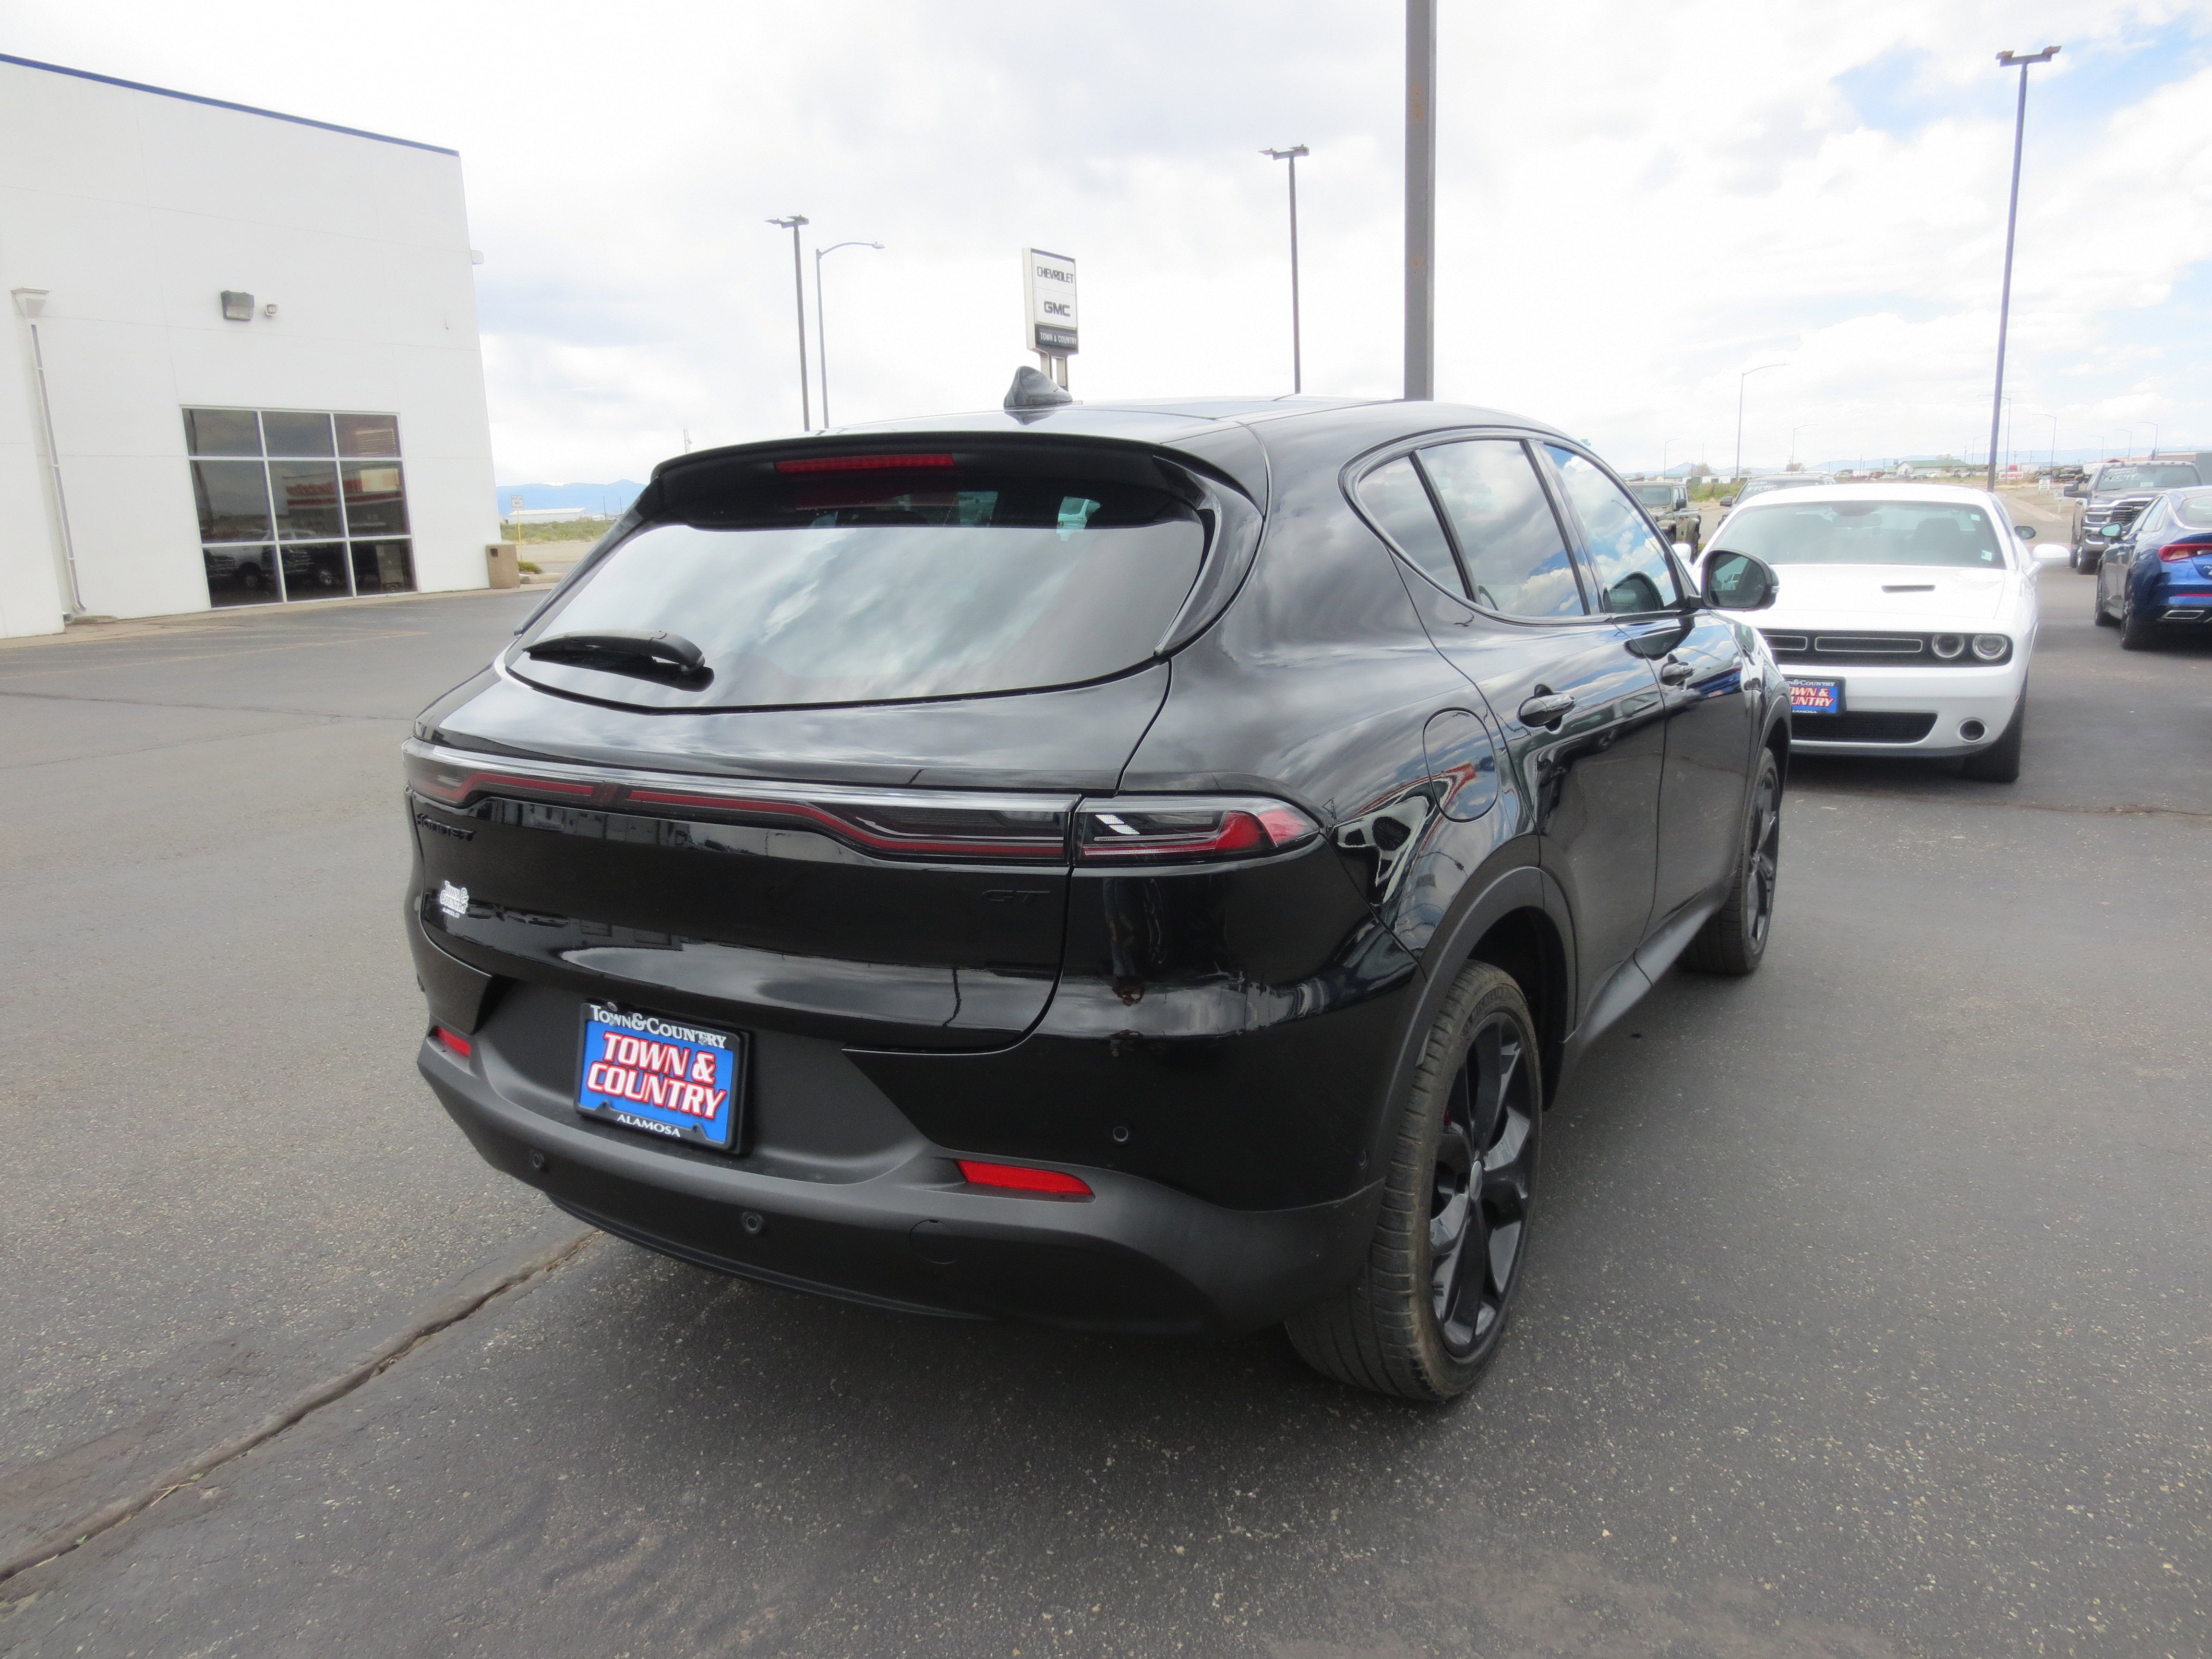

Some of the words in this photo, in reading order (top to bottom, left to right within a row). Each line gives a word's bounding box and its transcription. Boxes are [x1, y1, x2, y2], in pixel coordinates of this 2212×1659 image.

[1037, 266, 1074, 284] CHEVROLET
[1044, 301, 1071, 317] GMC
[1040, 332, 1053, 342] TOWN
[1054, 333, 1057, 342] &
[1058, 335, 1077, 345] COUNTRY
[1819, 688, 1829, 697] &
[1791, 696, 1835, 707] UNTRY
[980, 890, 1051, 903] GT
[603, 1031, 690, 1077] TOWN
[691, 1050, 716, 1085] &
[588, 1061, 727, 1119] COUNTRY
[617, 1114, 680, 1138] ALAMOSA
